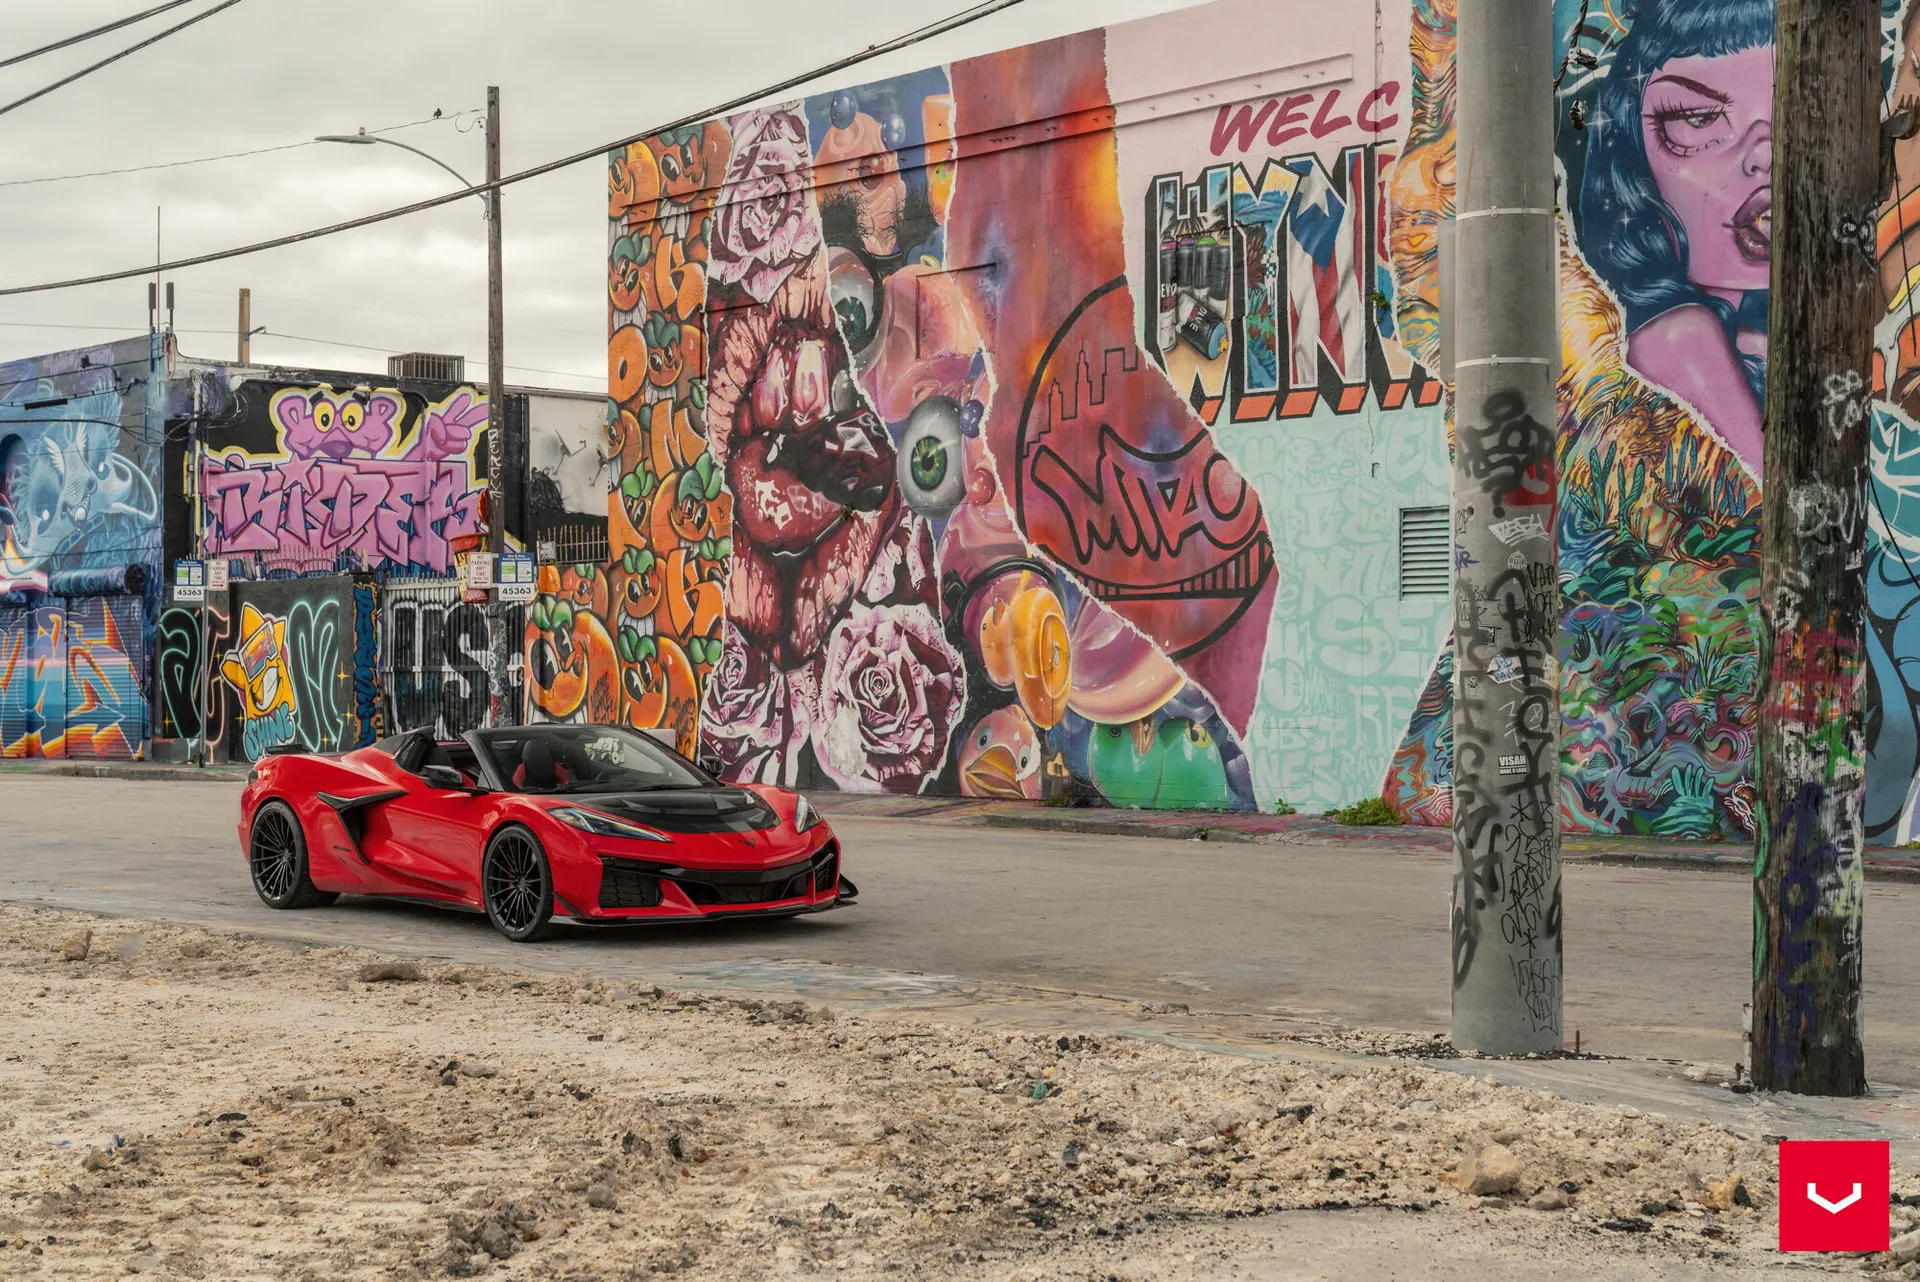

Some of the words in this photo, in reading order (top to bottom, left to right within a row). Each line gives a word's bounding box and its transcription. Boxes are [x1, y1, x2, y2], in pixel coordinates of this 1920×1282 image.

[1210, 81, 1400, 156] WELC
[177, 589, 202, 597] 45363
[501, 587, 532, 595] 45363
[245, 702, 294, 761] SHINE
[1499, 755, 1526, 767] VISAH
